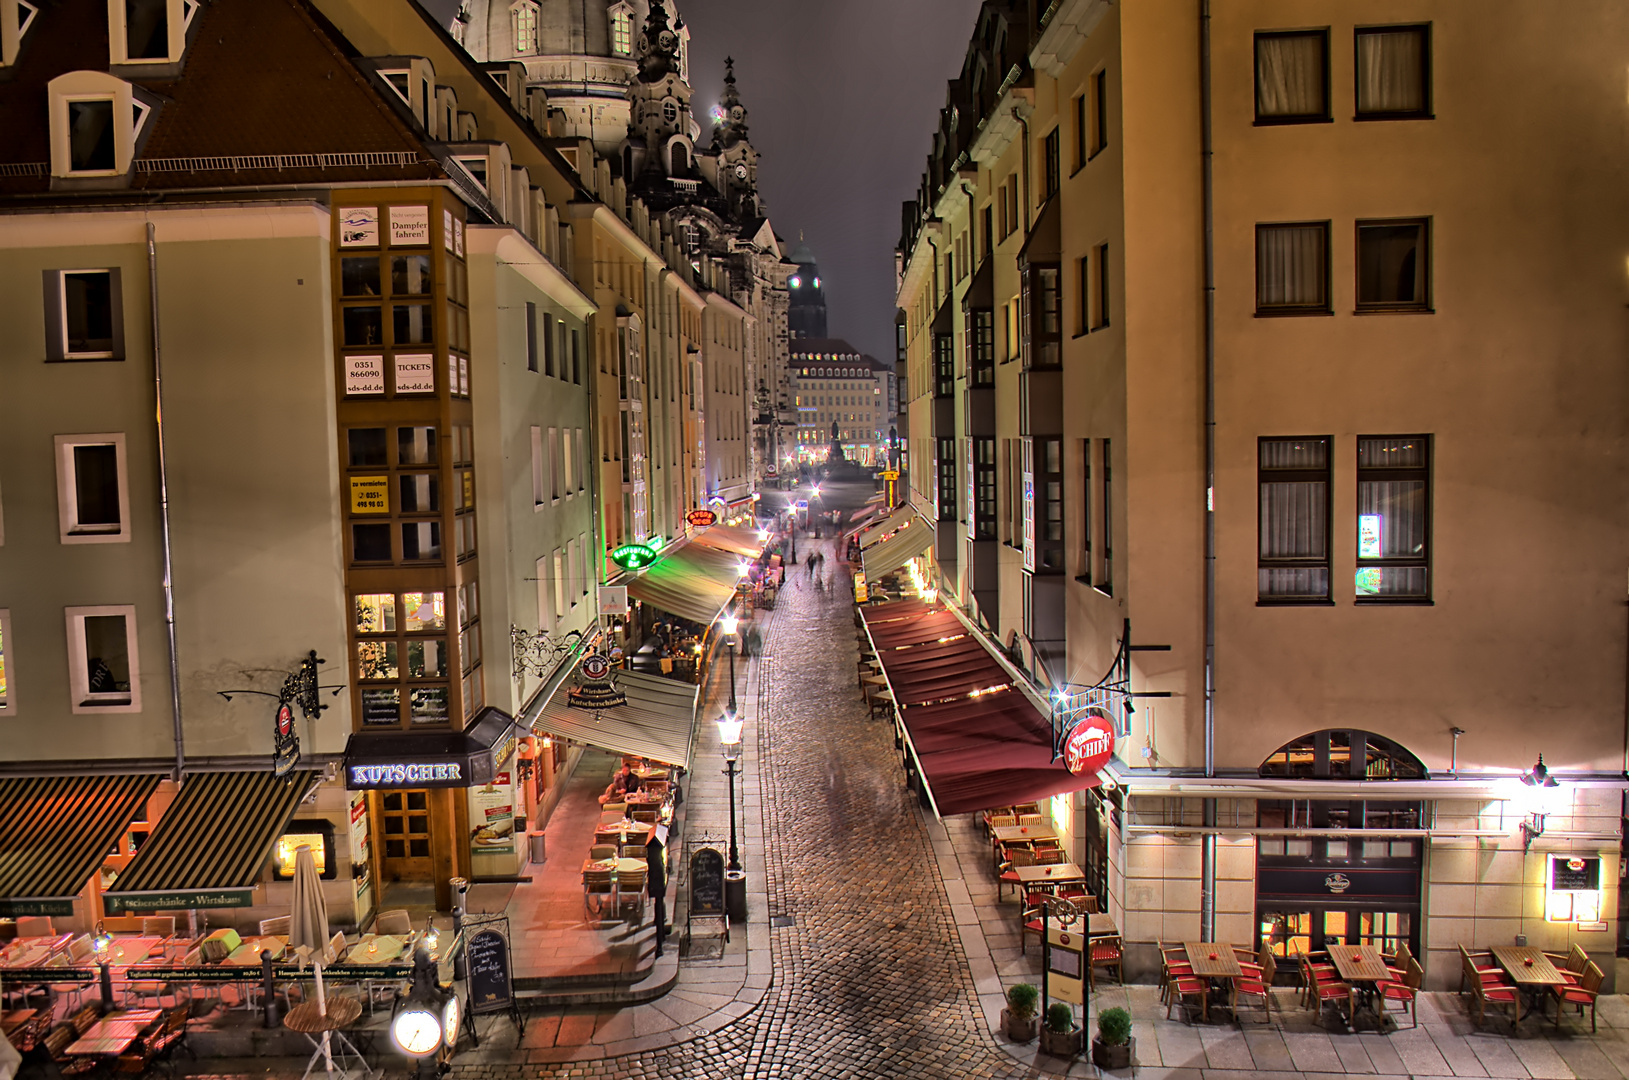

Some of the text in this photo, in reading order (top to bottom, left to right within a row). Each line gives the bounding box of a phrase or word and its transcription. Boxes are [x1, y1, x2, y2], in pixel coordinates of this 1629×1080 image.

[392, 222, 427, 230] Dampfer
[396, 230, 424, 238] fahren!
[613, 547, 654, 559] Restaurant
[570, 697, 624, 707] Kutscherschänke
[1068, 731, 1111, 762] SCHIFF
[352, 763, 462, 784] KUTSCHER
[114, 897, 186, 908] Ktscherschänke
[196, 895, 241, 905] Wirtshaus
